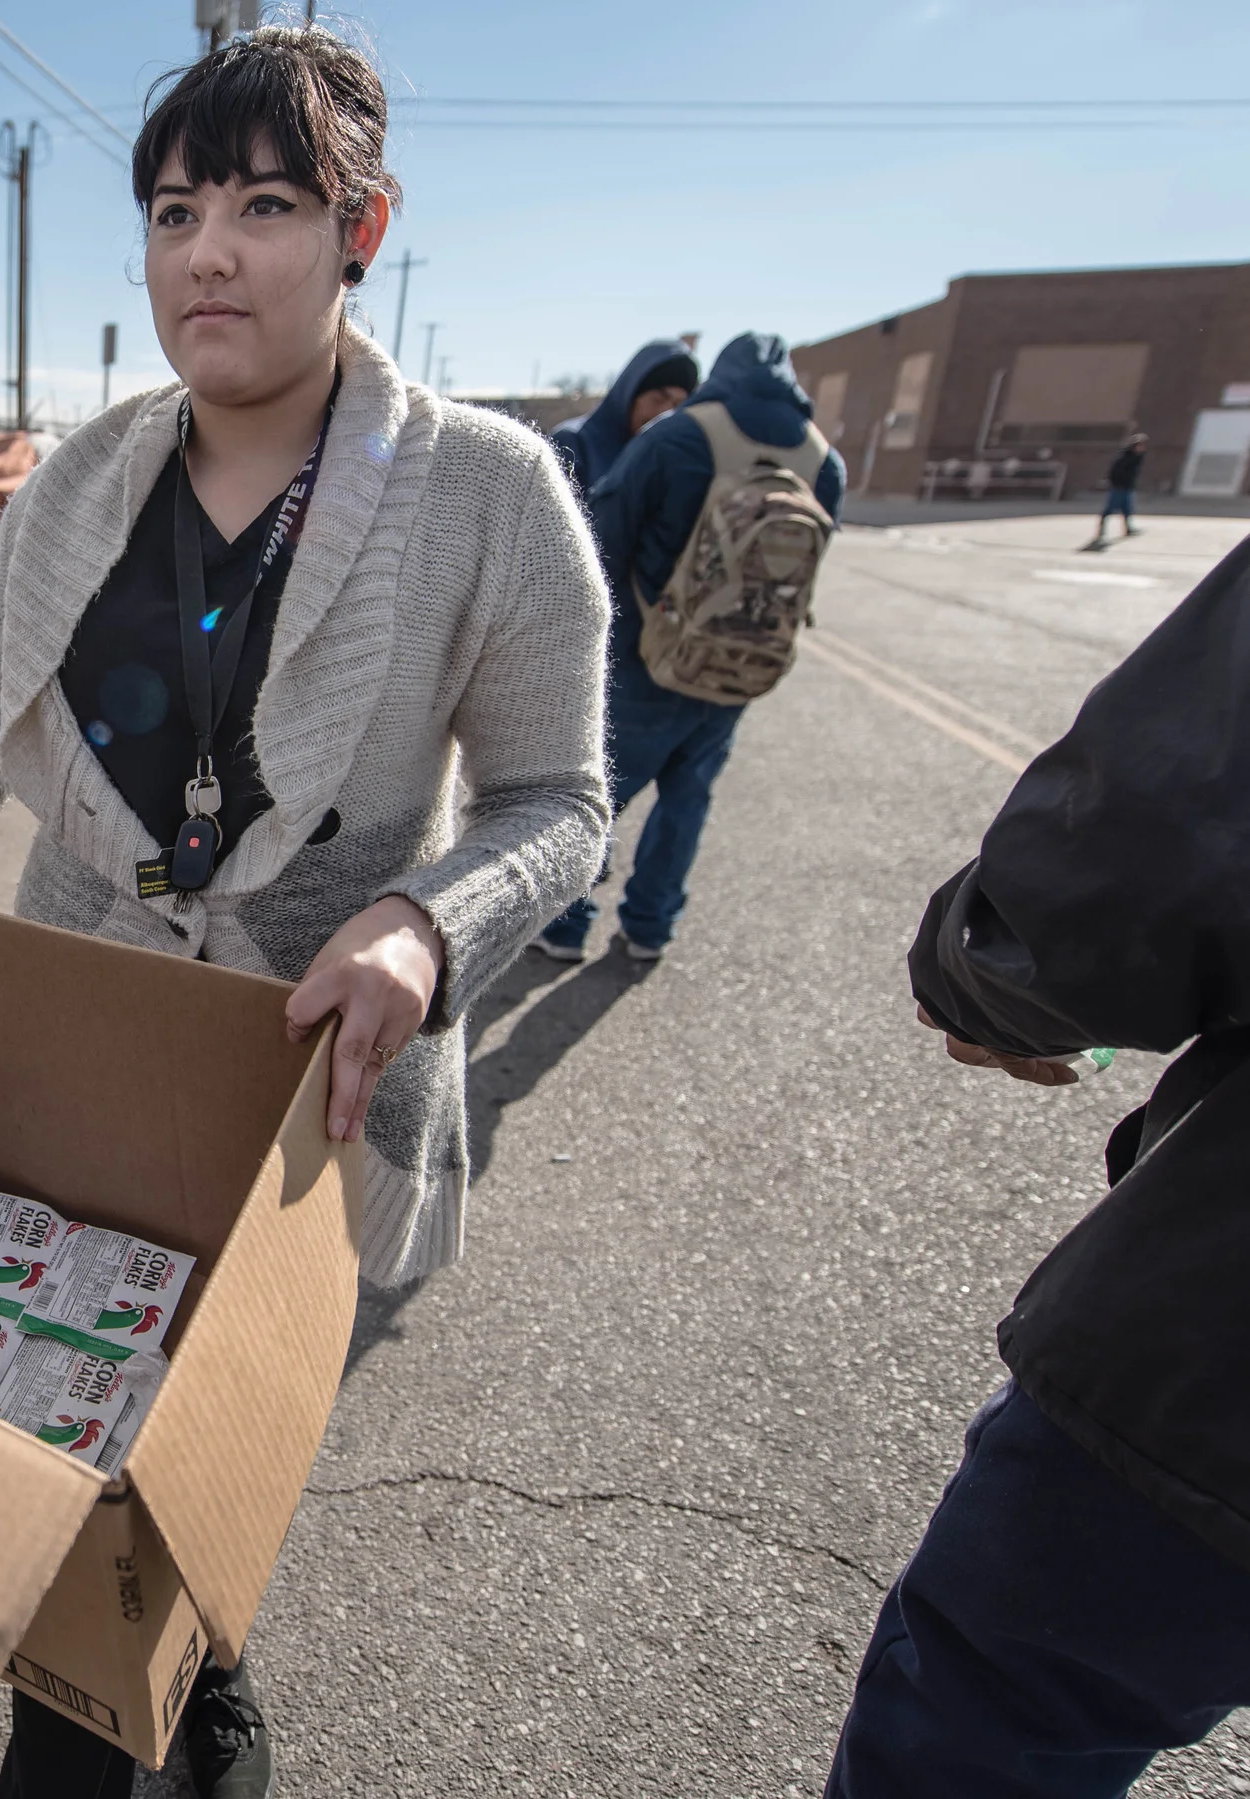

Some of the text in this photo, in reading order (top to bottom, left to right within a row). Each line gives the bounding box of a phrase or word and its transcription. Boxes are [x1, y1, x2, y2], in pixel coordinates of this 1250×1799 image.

[263, 483, 307, 567] WHITE
[10, 1207, 34, 1243] FLAKES
[26, 1212, 52, 1248] CORN
[44, 1220, 59, 1247] Kellogg's
[125, 1247, 151, 1286] FLAKES
[140, 1253, 168, 1291] CORN
[160, 1261, 178, 1290] Kellogg's
[69, 1354, 99, 1399] FLAKES
[85, 1361, 117, 1404] CORN
[105, 1371, 124, 1403] Kellogg's
